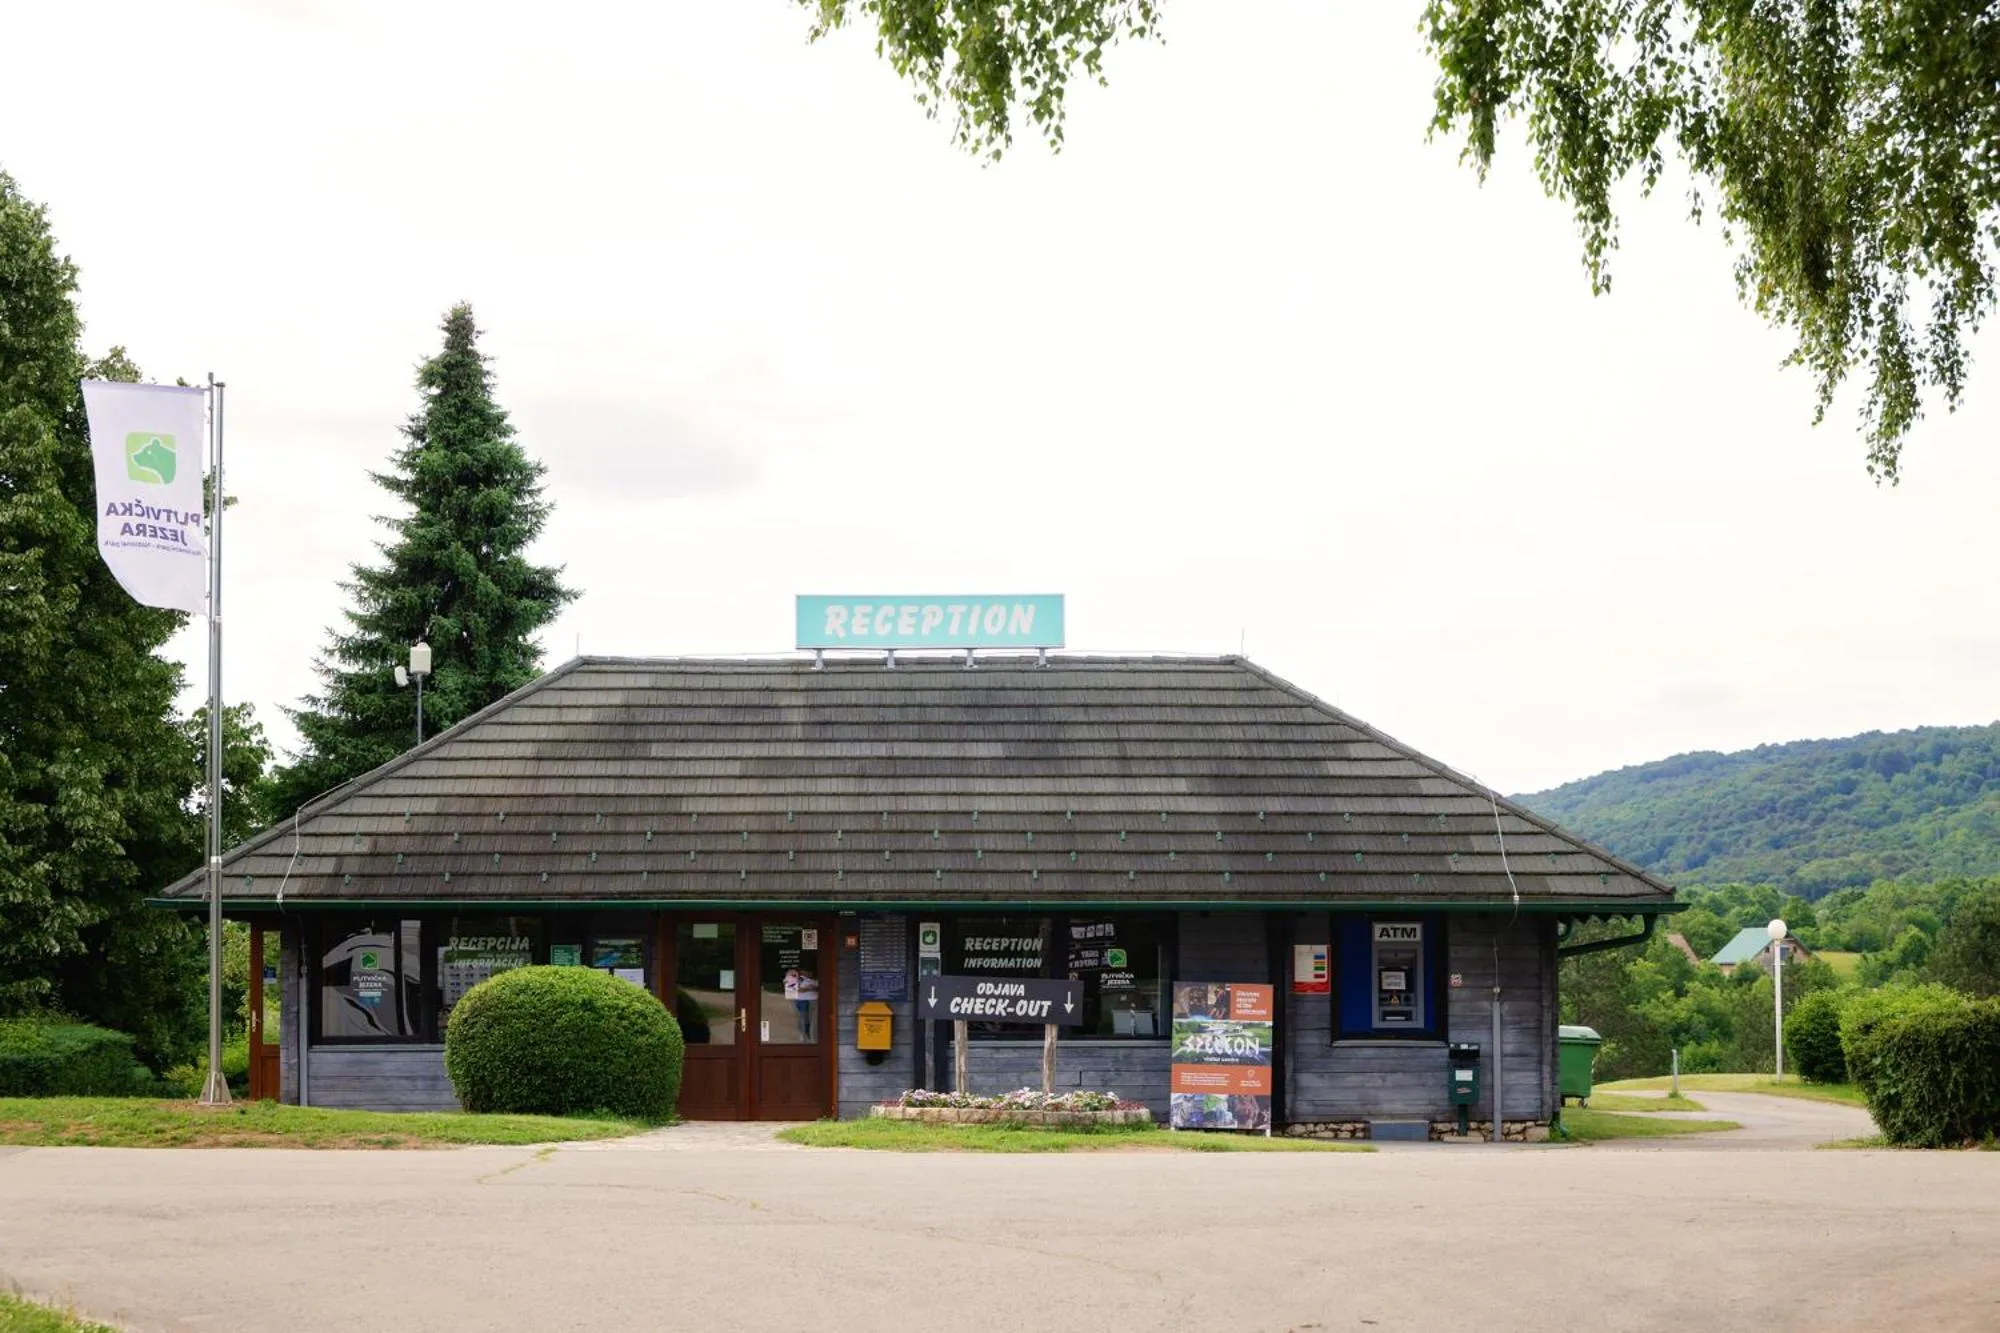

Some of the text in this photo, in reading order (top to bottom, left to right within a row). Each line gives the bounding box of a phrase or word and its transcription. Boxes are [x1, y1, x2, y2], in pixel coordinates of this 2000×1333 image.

[824, 603, 1036, 639] RECEPTION
[1379, 927, 1417, 939] ATM
[448, 936, 530, 951] RECEPCIJA
[964, 937, 1043, 951] RECEPTION
[963, 957, 1042, 968] INFORMATION
[976, 982, 1025, 996] ODJAVA
[950, 996, 1052, 1017] CHECK-OUT
